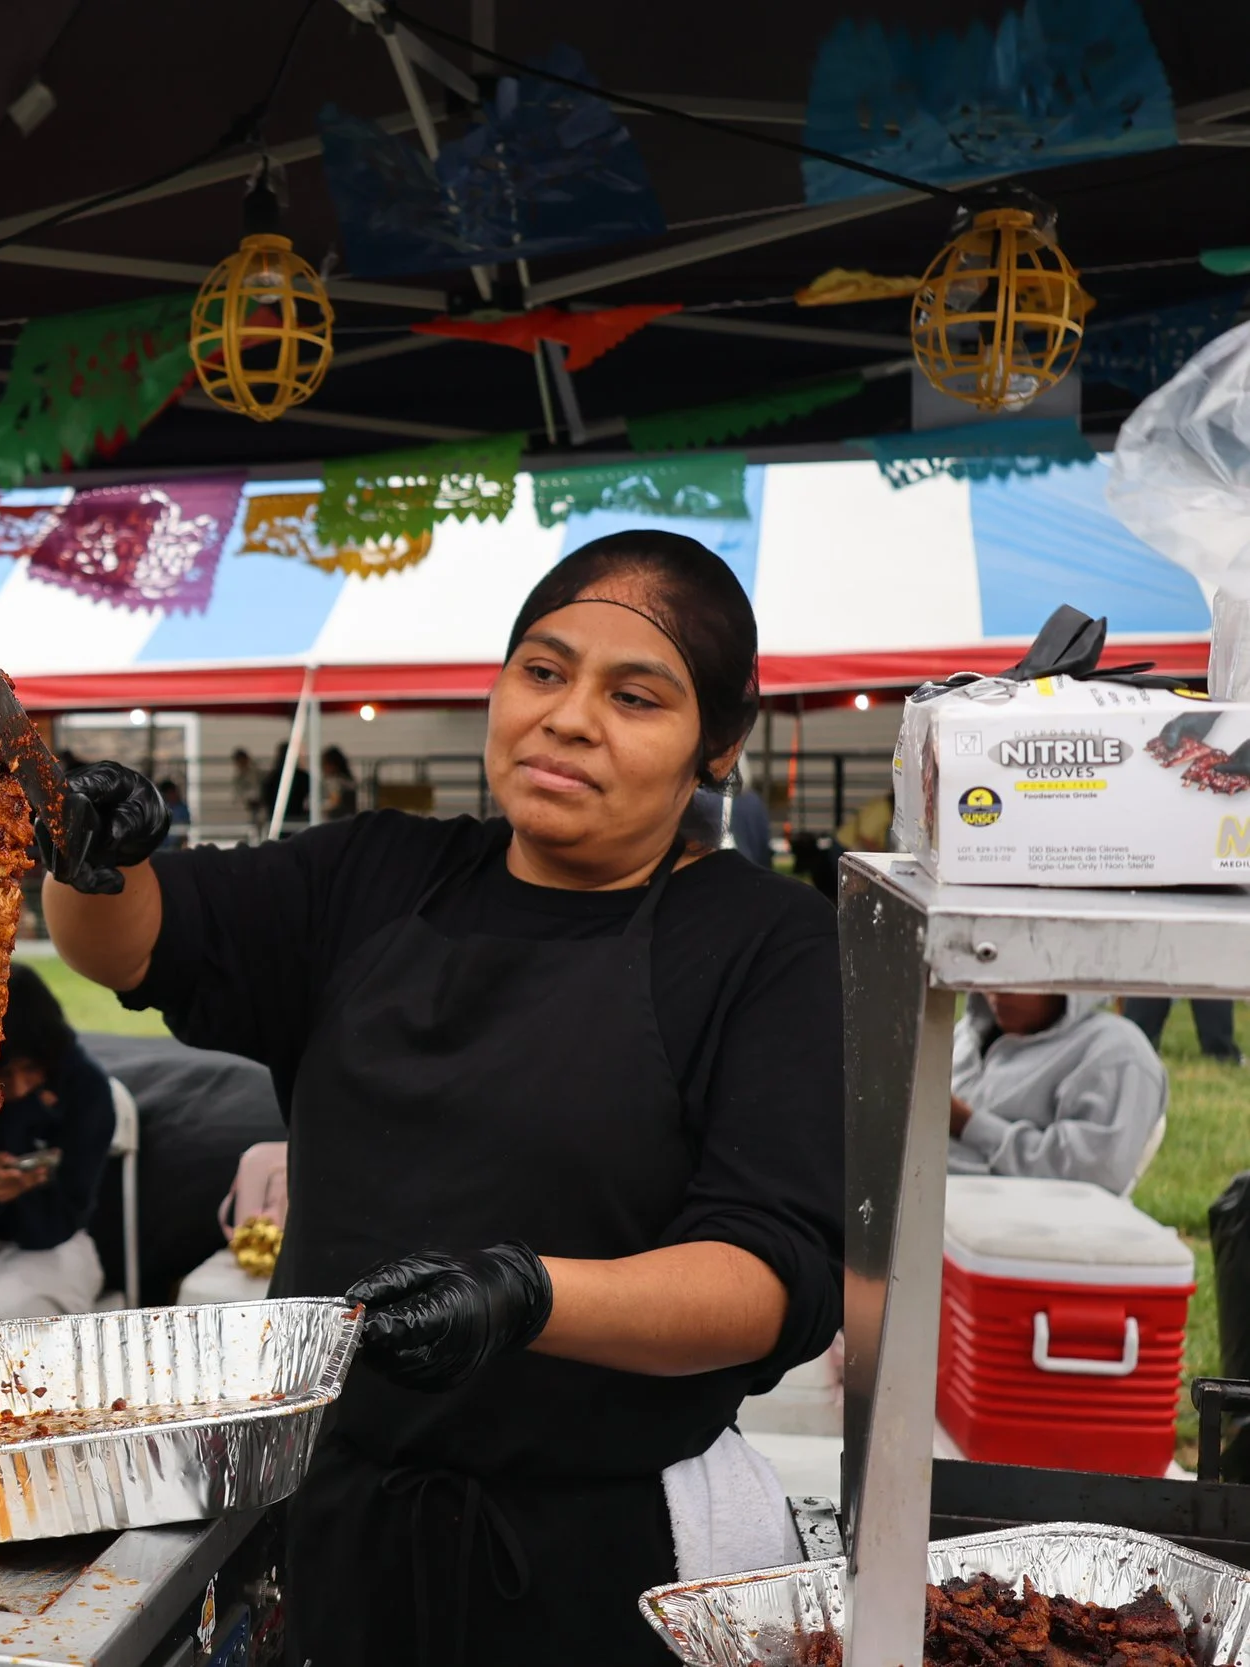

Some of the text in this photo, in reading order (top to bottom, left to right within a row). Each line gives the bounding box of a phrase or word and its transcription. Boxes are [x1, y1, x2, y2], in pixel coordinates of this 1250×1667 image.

[1000, 738, 1122, 766] NITRILE
[1026, 767, 1095, 779] GLOVES
[1024, 792, 1070, 800] Foodservice
[962, 811, 1000, 825] SUNSET
[1045, 845, 1068, 853] Black
[1071, 845, 1097, 853] Nitrile
[1099, 845, 1129, 853] Gloves
[1045, 854, 1082, 862] Guantes
[1099, 853, 1125, 861] Nitrilo
[1127, 853, 1156, 862] Negro
[1078, 862, 1097, 871] Only
